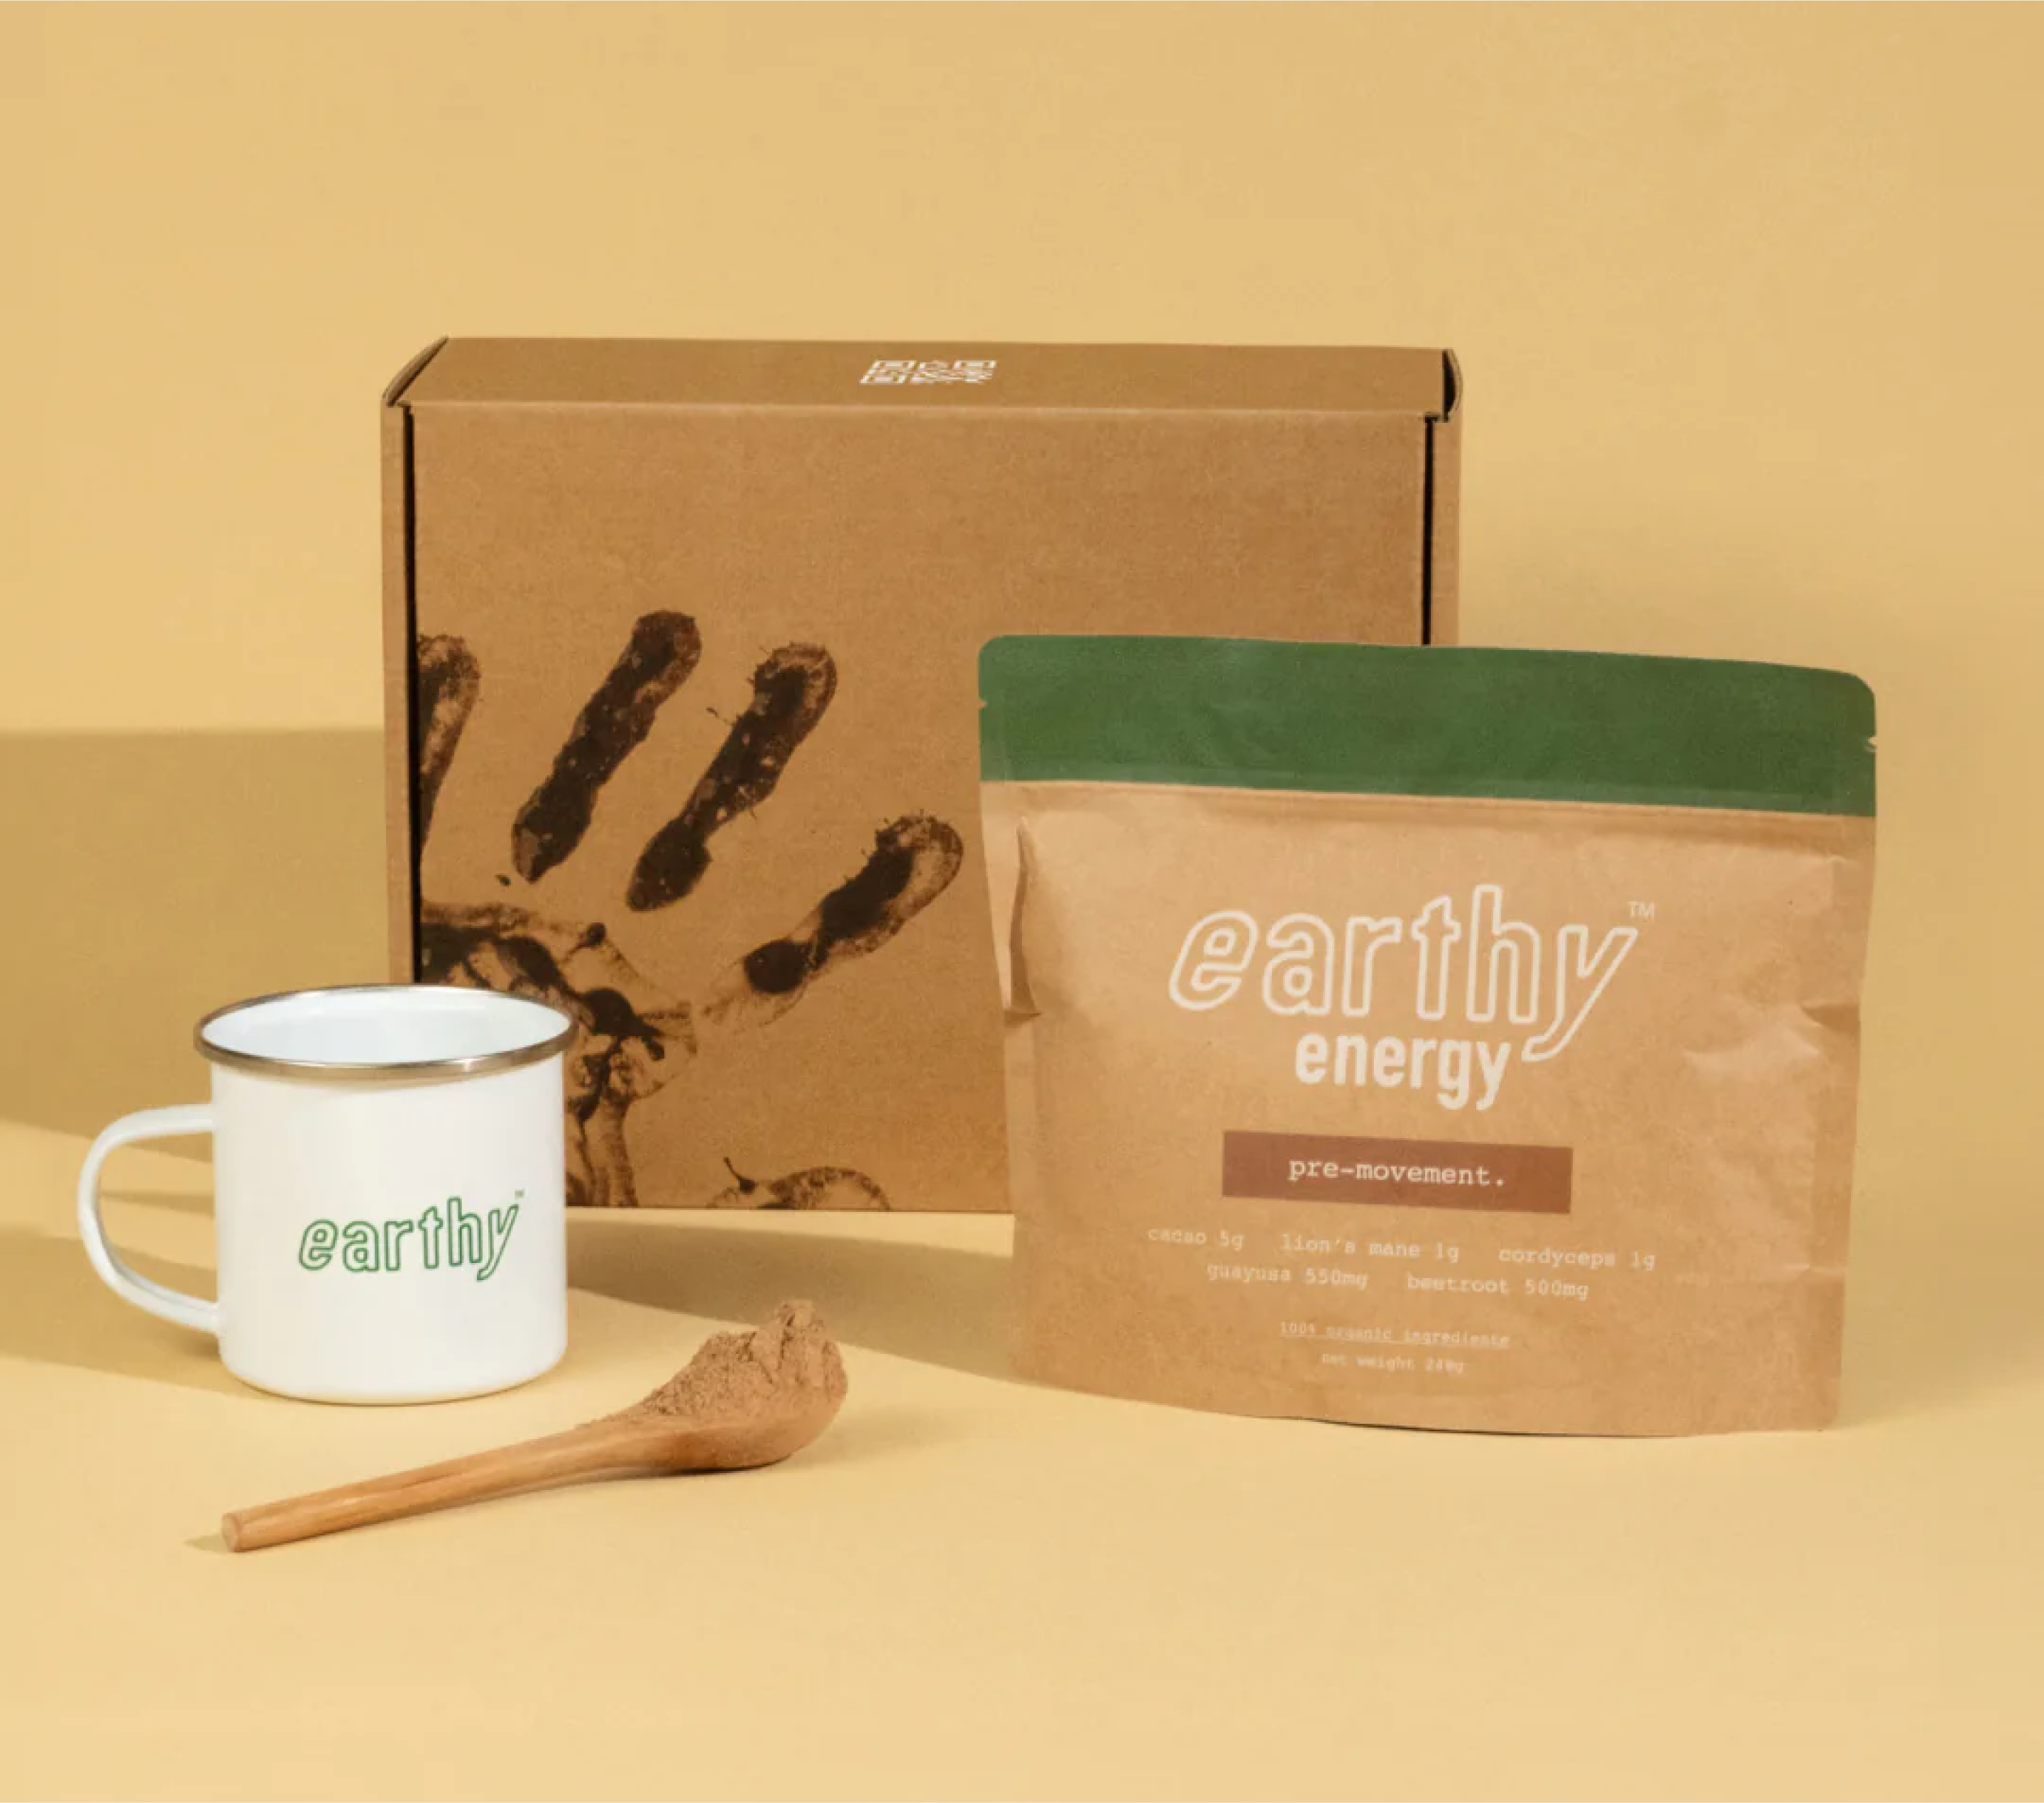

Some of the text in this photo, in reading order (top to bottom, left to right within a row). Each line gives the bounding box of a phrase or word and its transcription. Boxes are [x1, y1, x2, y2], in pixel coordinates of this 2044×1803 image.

[1169, 884, 1639, 1062] earthy
[1295, 1032, 1511, 1111] energy
[1287, 1159, 1505, 1186] pre-movement.
[298, 1196, 520, 1282] earthy
[1147, 1228, 1207, 1245] cacao
[1219, 1229, 1245, 1252] 5g
[1369, 1241, 1420, 1257] mane
[1436, 1242, 1460, 1263] 1g
[1498, 1246, 1616, 1270] cordyceps
[1632, 1250, 1656, 1271] 1g
[1207, 1262, 1589, 1301] guayusa 550mg beetroot 500mg
